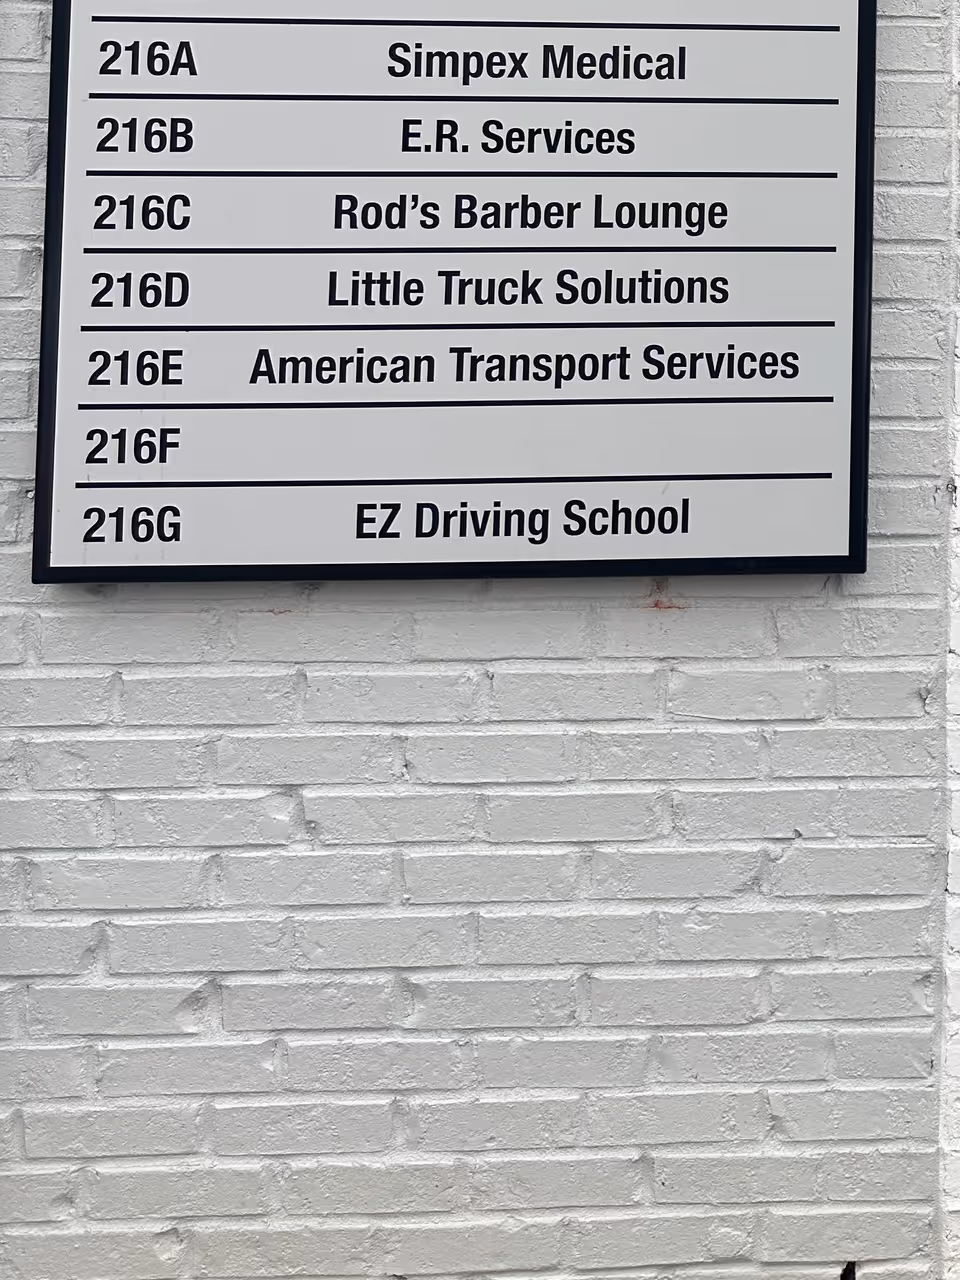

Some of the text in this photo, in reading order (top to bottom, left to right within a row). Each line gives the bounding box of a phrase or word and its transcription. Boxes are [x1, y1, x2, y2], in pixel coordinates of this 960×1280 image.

[99, 41, 685, 85] 216A Simpex Medical
[96, 118, 635, 154] 216B E.R. Services
[94, 195, 727, 236] 216C Rod's Barber Lounge
[91, 269, 728, 307] 216D Little Truck Solutions
[88, 344, 799, 389] 216E American Transport Services
[86, 428, 180, 464] 216F
[83, 499, 689, 544] 216G EZ Driving School
